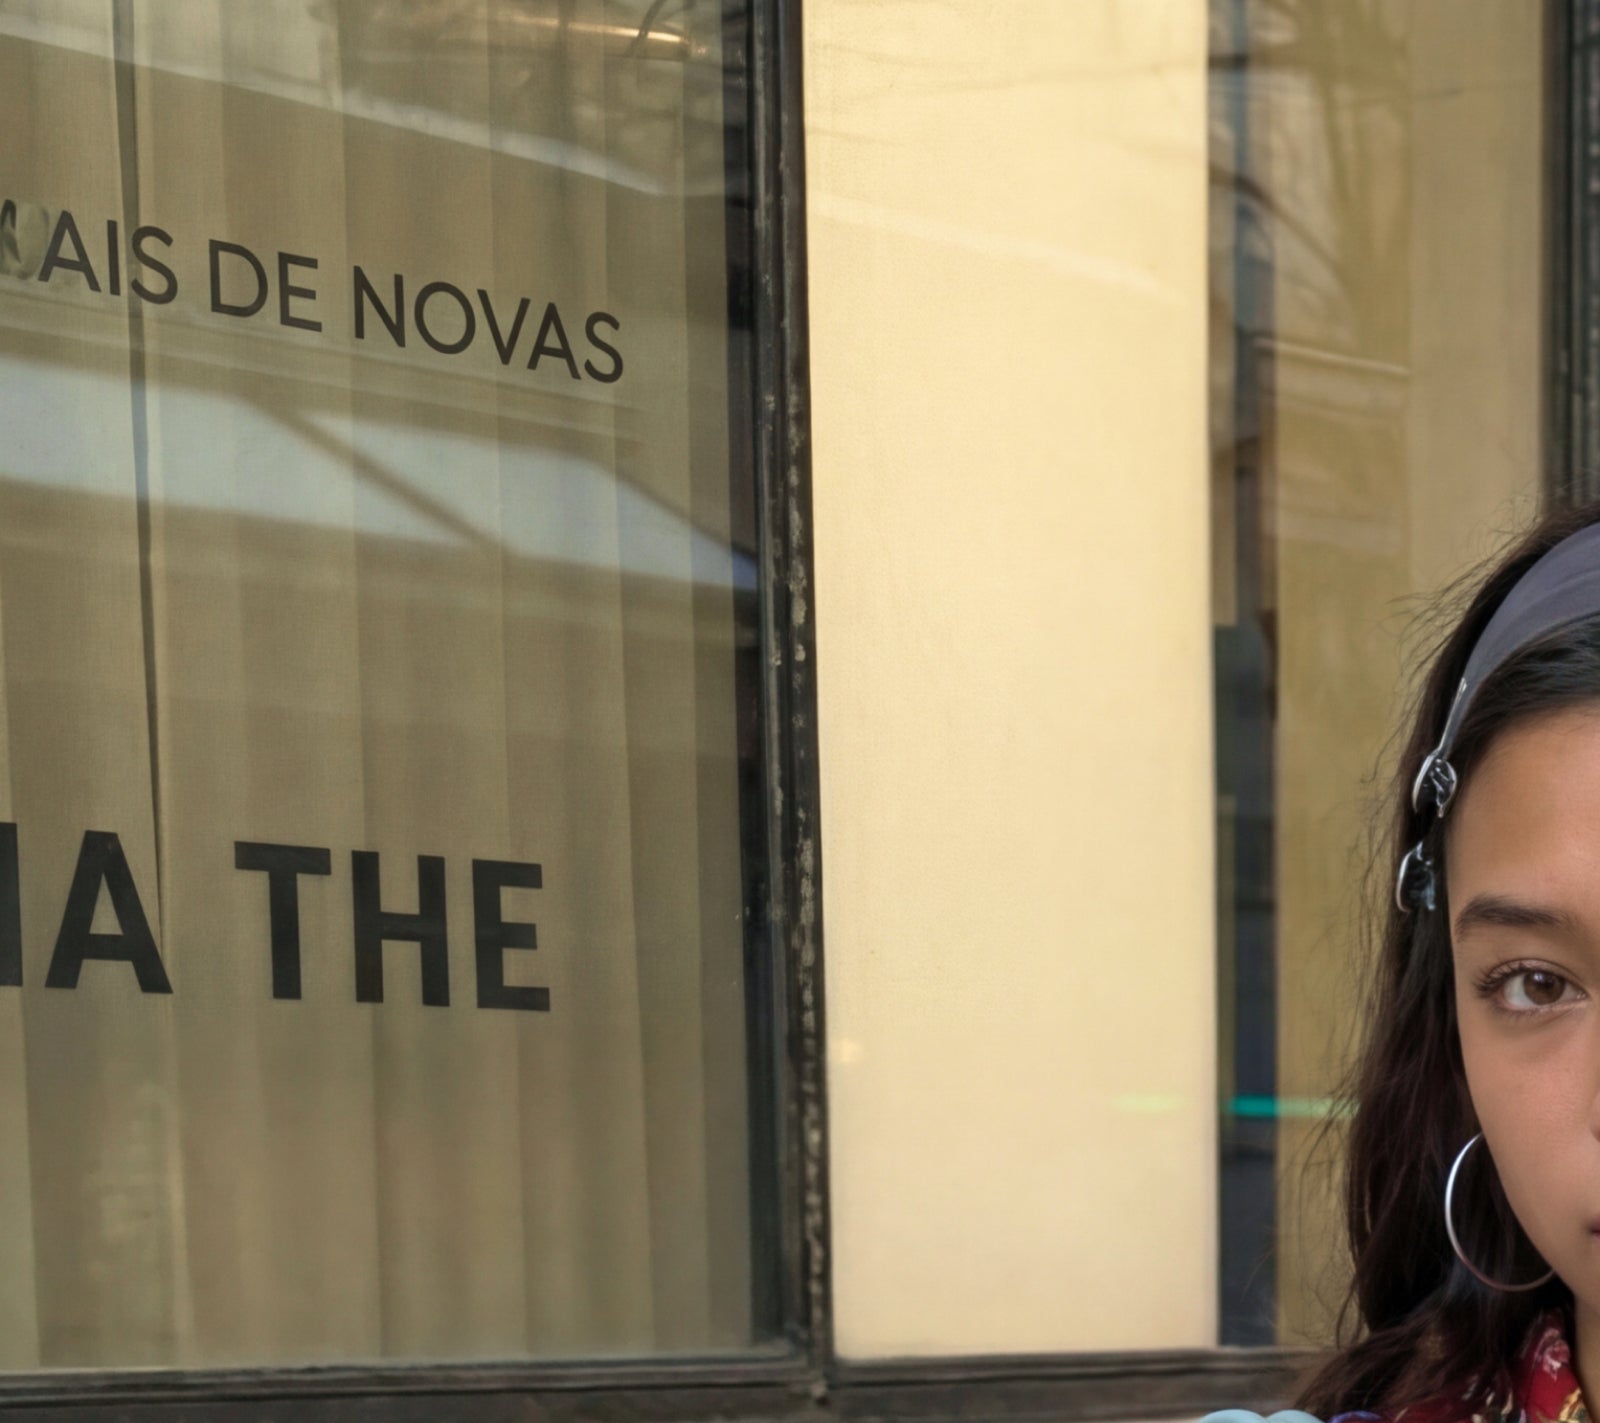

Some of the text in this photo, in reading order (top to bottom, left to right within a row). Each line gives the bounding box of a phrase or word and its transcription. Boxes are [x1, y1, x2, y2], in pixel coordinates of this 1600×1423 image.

[209, 239, 322, 332] DE
[353, 265, 624, 384] NOVAS
[234, 840, 550, 1012] THE
